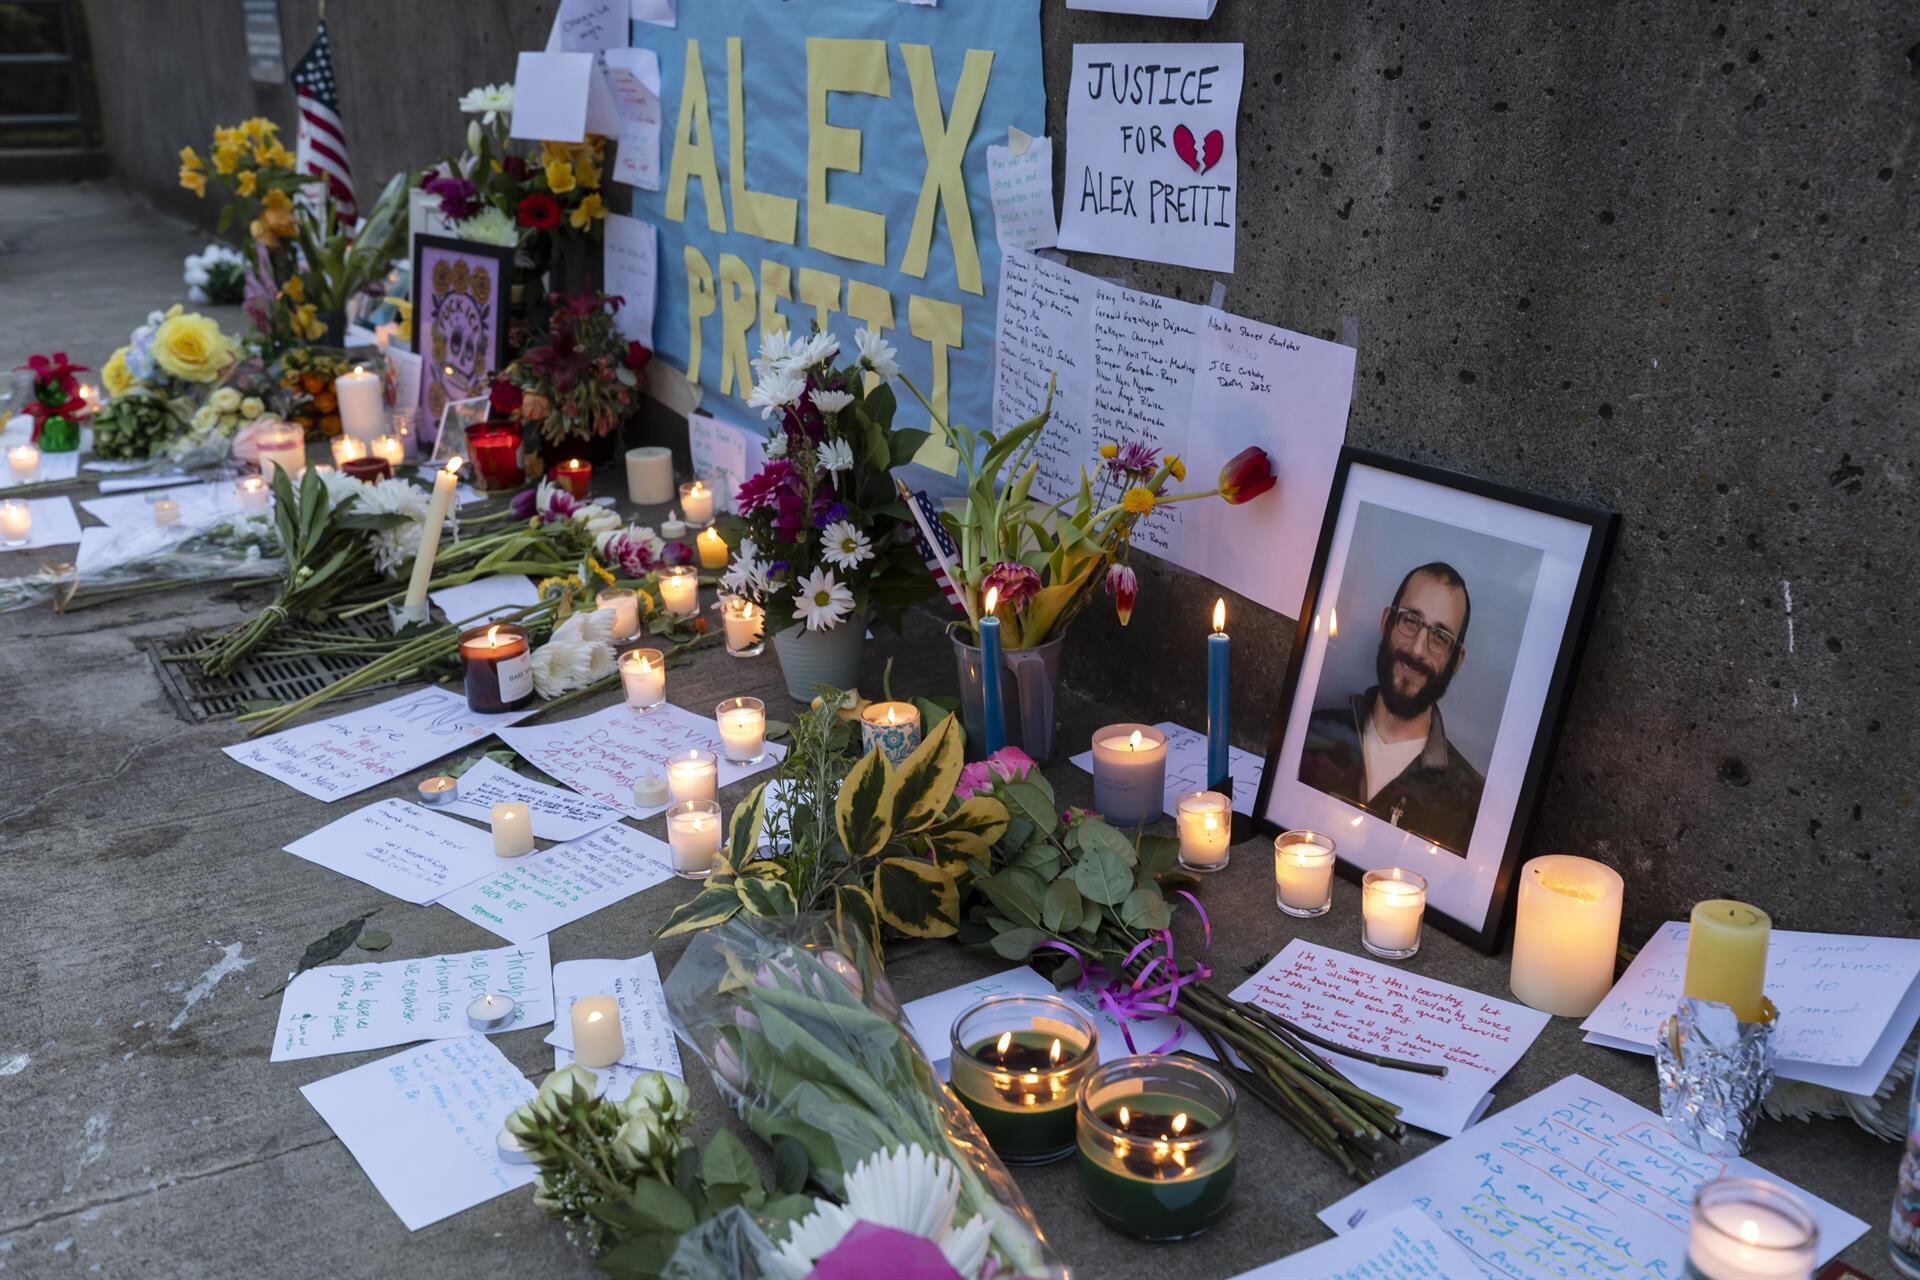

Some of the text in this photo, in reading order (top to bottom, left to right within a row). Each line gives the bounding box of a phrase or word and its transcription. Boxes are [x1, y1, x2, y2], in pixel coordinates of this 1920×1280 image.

[1087, 62, 1219, 106] JUSTICE
[1119, 125, 1167, 155] FOR
[664, 36, 995, 296] ALEX
[1080, 165, 1232, 228] ALEX PRETTI
[683, 245, 964, 478] PRETTI
[1250, 381, 1272, 393] 2025
[1279, 968, 1304, 982] you
[1310, 975, 1342, 991] have
[1353, 988, 1384, 1006] been
[1415, 1008, 1452, 1026] great
[1459, 1022, 1511, 1044] service
[1286, 979, 1312, 994] this
[1321, 990, 1356, 1008] same
[1294, 961, 1318, 974] you
[1326, 969, 1361, 986] down
[1477, 1016, 1513, 1034] since
[1347, 965, 1377, 985] sorry
[1382, 976, 1410, 992] this
[1416, 985, 1465, 1009] country
[1479, 1003, 1503, 1017] let
[1252, 982, 1296, 1002] Thank
[1301, 999, 1327, 1012] you
[1332, 1008, 1358, 1022] for
[1356, 1016, 1377, 1029] all
[1385, 1022, 1410, 1038] you
[1414, 1032, 1446, 1051] have
[1261, 997, 1292, 1011] wish
[1300, 1009, 1324, 1024] you
[1331, 1020, 1361, 1033] were
[1366, 1029, 1392, 1045] still
[1311, 1021, 1336, 1034] the
[1501, 1139, 1540, 1157] of
[1538, 1115, 1581, 1146] his
[1552, 1108, 1620, 1148] Alex
[1474, 1151, 1506, 1176] As
[1515, 1183, 1545, 1205] an
[1512, 1125, 1647, 1205] the lives
[1480, 1176, 1507, 1204] he
[1453, 1227, 1474, 1247] an
[1460, 1203, 1515, 1238] and
